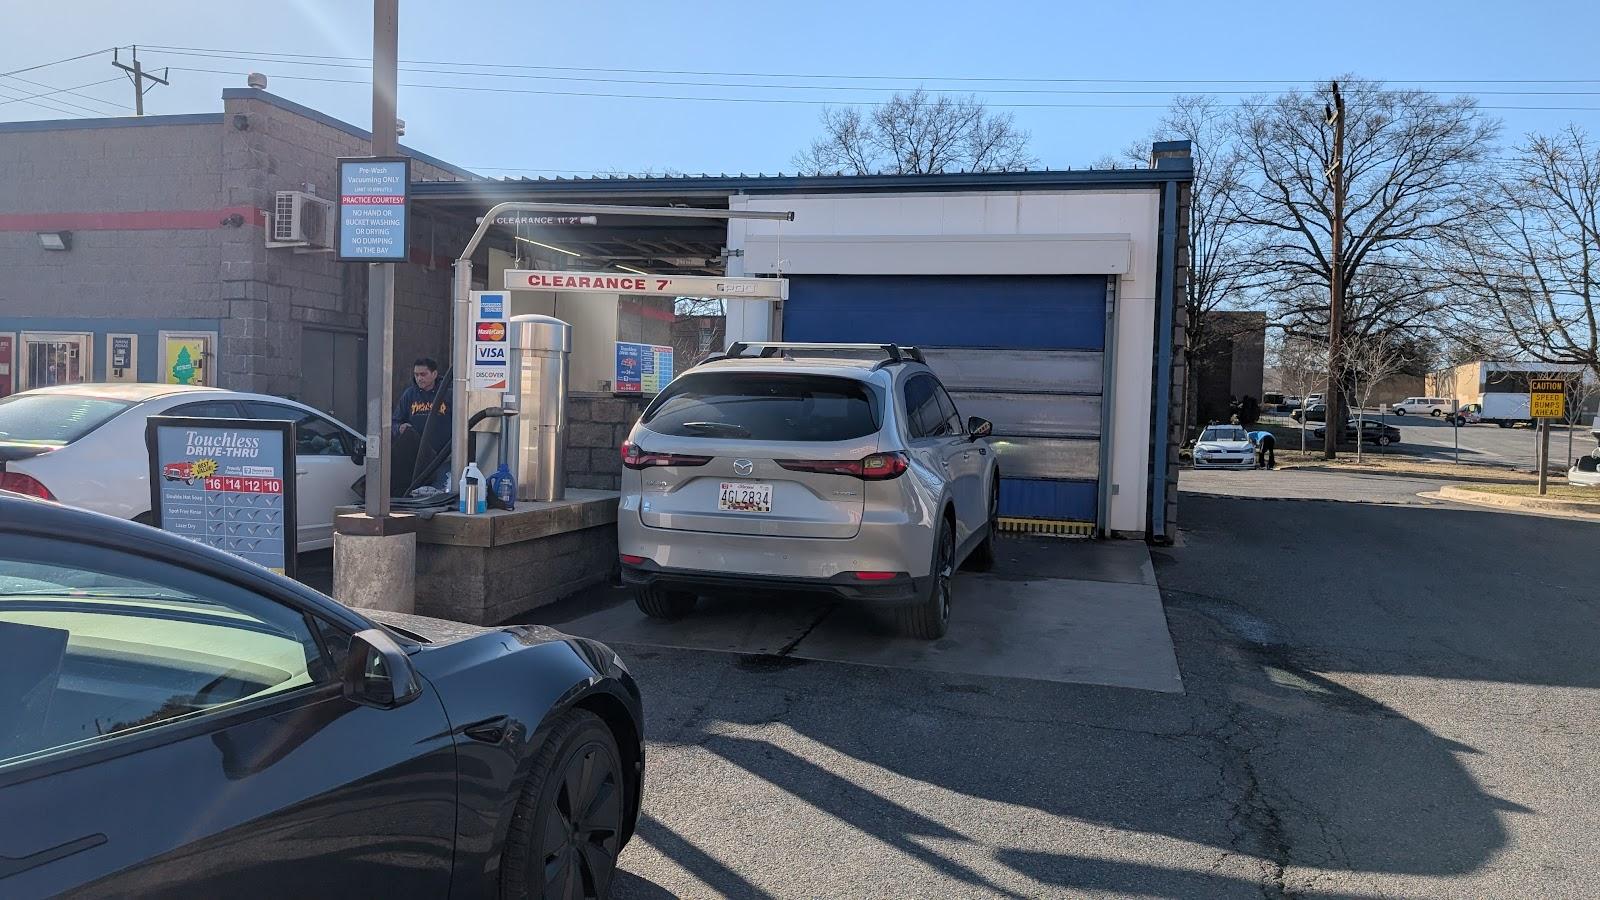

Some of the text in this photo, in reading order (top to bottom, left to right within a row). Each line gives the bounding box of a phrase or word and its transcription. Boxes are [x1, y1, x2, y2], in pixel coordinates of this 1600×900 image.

[347, 176, 381, 184] Vacuuming
[342, 196, 405, 204] PRACTICE COURTESY
[496, 217, 553, 225] CLEARANCE
[528, 275, 672, 291] CLEARANCE 7'
[479, 348, 504, 358] VISA
[1533, 382, 1562, 390] CAUTION
[186, 431, 260, 448] Touchless
[186, 447, 259, 458] DRIVE-THRU
[206, 479, 221, 489] $16
[226, 479, 241, 489] $14
[245, 480, 260, 491] $12
[264, 481, 280, 492] $10
[722, 490, 769, 505] 4GL2834
